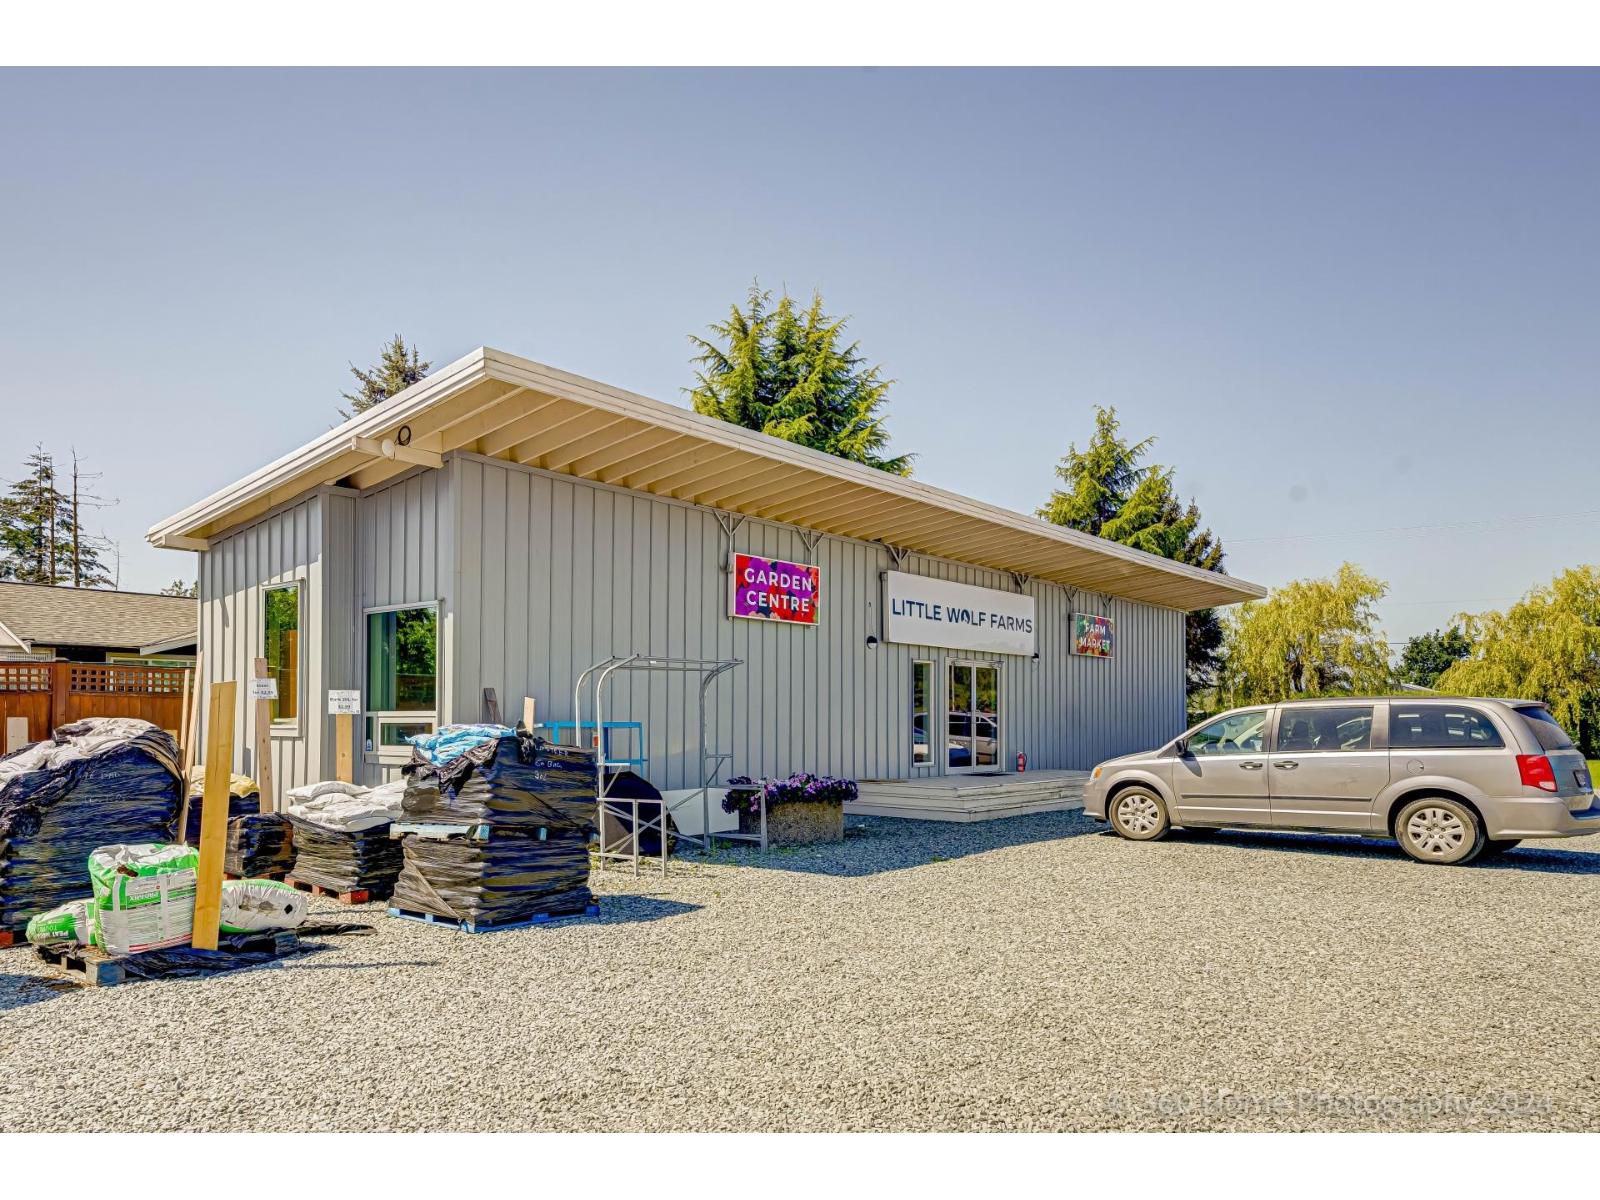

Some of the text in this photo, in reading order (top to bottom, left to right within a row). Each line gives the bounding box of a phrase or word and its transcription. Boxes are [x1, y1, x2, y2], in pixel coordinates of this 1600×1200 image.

[744, 567, 812, 592] GARDEN
[746, 590, 810, 612] CENTRE
[892, 598, 1033, 634] LITTLE WOLF FARMS
[1085, 622, 1106, 636] FARM
[1080, 636, 1110, 651] MARKET
